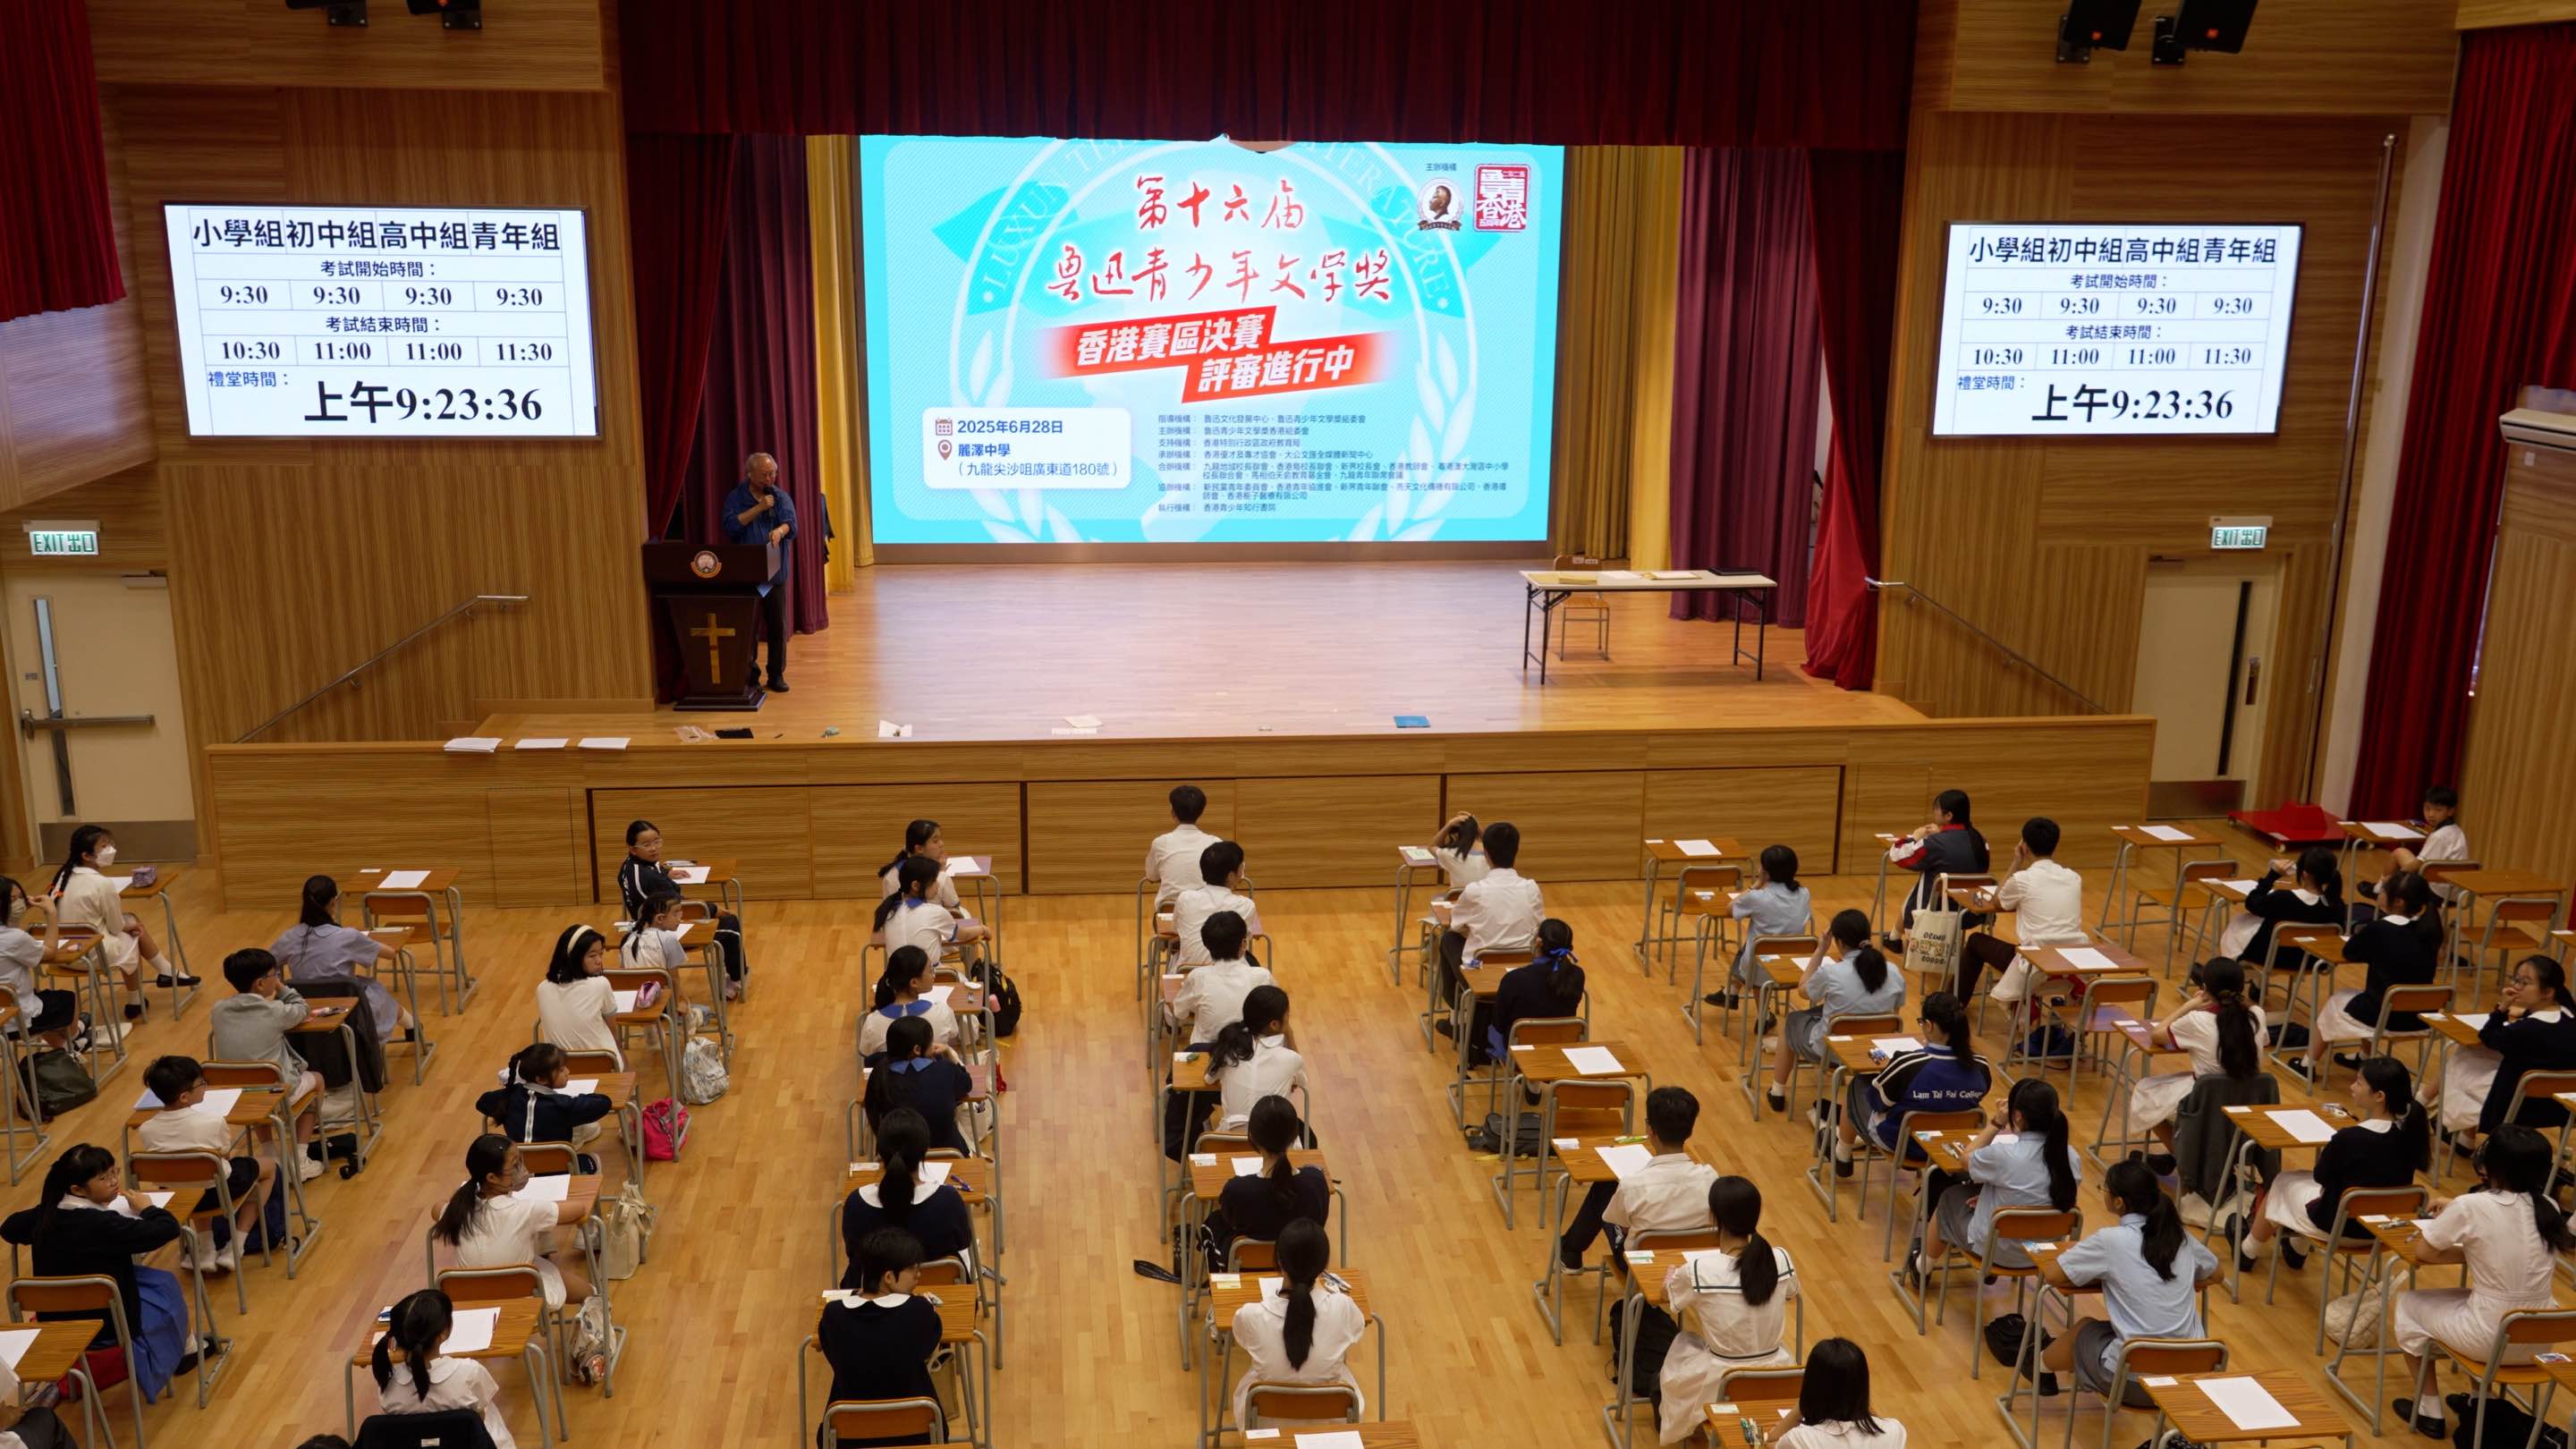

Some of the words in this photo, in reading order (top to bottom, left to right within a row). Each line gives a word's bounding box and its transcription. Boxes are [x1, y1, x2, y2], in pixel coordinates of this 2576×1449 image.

[193, 218, 284, 249] 小學組
[285, 219, 377, 250] 初中組
[379, 221, 469, 250] 高中組
[471, 221, 561, 251] 青年組
[1969, 236, 2044, 263] 小學組
[2047, 237, 2123, 263] 初中組
[2124, 238, 2199, 264] 高中組
[2203, 238, 2276, 264] 青年組
[320, 260, 436, 278] 考試開始時間：
[2070, 274, 2168, 290] 考試開始時間：
[220, 285, 268, 305] 9:30
[313, 286, 361, 305] 9:30
[405, 287, 453, 306] 9:30
[496, 288, 543, 307] 9:30
[1983, 297, 2022, 315] 9:30
[2060, 297, 2100, 315] 9:30
[2137, 297, 2177, 315] 9:30
[2214, 297, 2253, 315] 9:30
[325, 316, 441, 334] 考試結束時間：
[2064, 324, 2162, 341] 考試結束時間：
[1076, 313, 1264, 367] 香港賽區決賽
[221, 341, 281, 360] 10:30
[314, 342, 372, 361] 11:00
[405, 343, 463, 362] 11:00
[496, 343, 553, 362] 11:30
[1973, 348, 2023, 366] 10:30
[2051, 348, 2100, 366] 11:00
[2128, 348, 2176, 366] 11:00
[2204, 348, 2252, 366] 11:30
[1197, 344, 1355, 394] 評審進行中
[208, 370, 289, 388] 禮堂時間：
[1957, 376, 2025, 391] 禮堂時間：
[304, 381, 543, 423] 上午9:23:36
[2031, 383, 2234, 424] 上午9:23:36
[957, 419, 1063, 434] 2025年6月28日
[958, 444, 1011, 457] 麗澤中學
[33, 533, 64, 553] EXIT
[68, 533, 95, 553] 出口
[2214, 529, 2240, 546] EXIT
[2241, 529, 2263, 546] 出口
[1912, 1089, 1929, 1099] Lam
[1932, 1089, 1943, 1099] Tai
[1945, 1089, 1957, 1099] Fai
